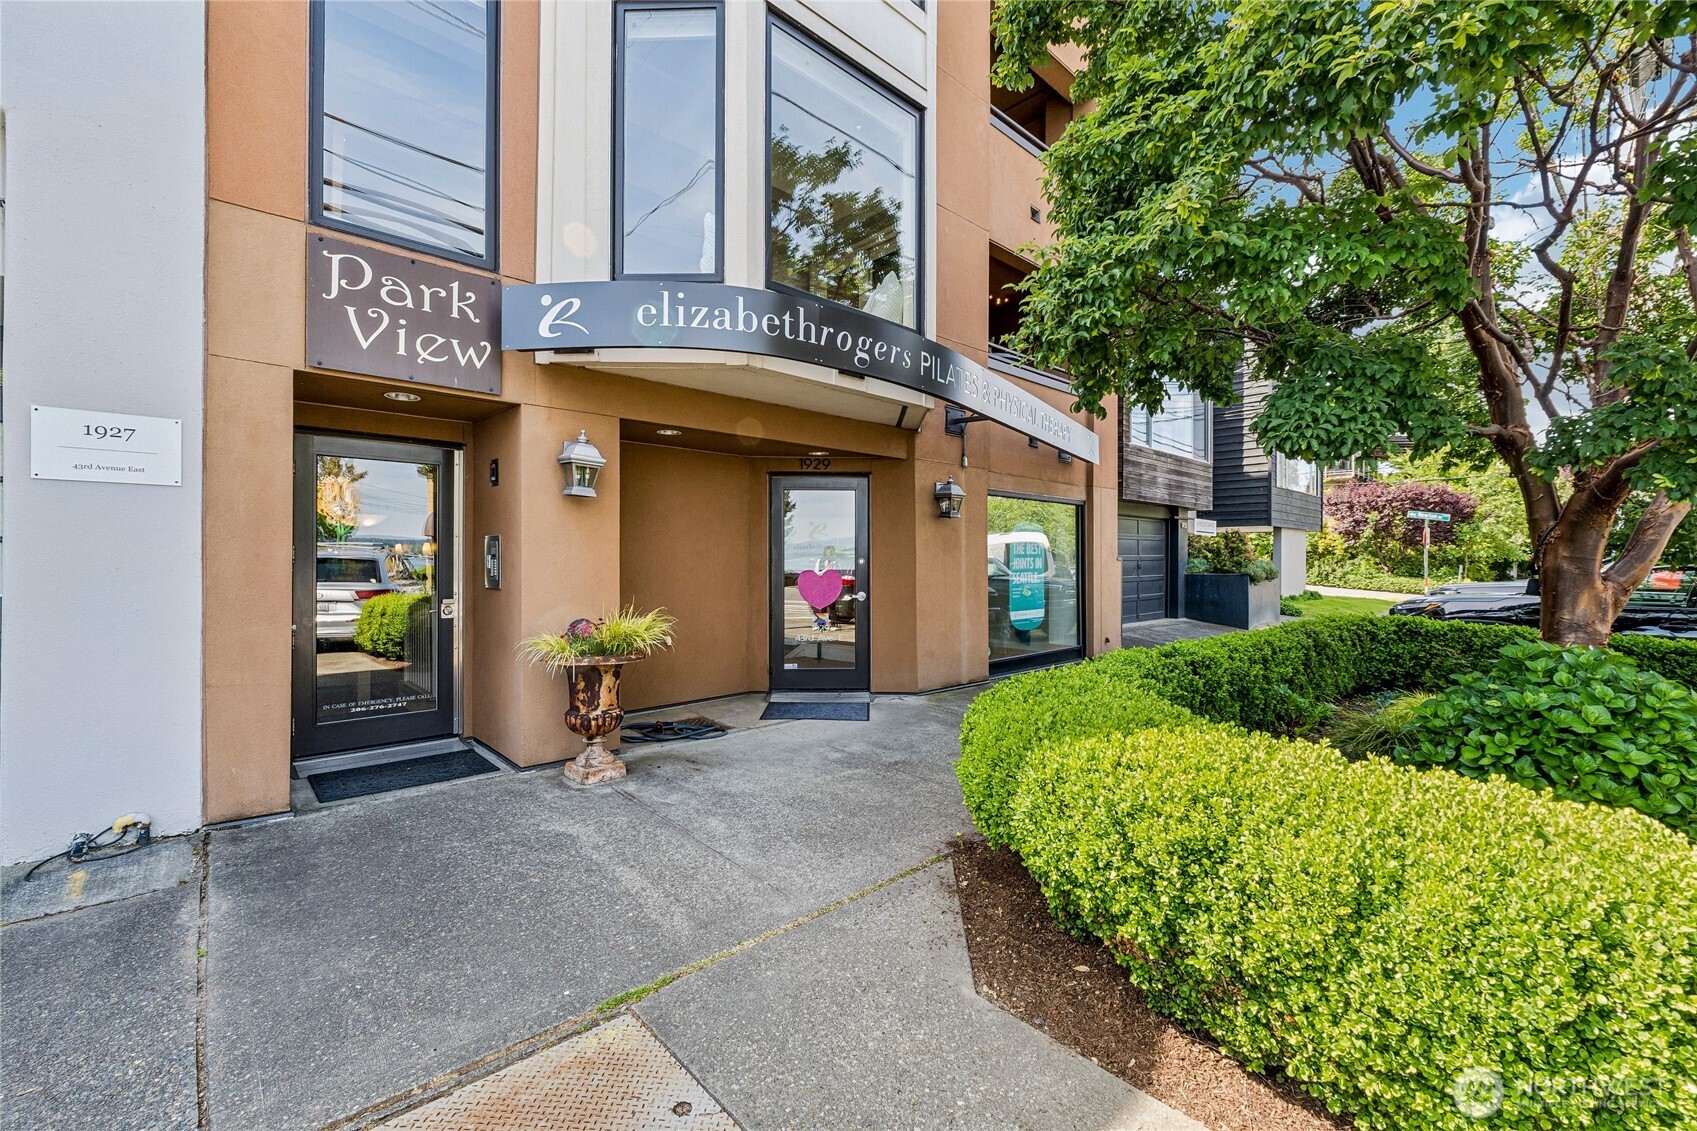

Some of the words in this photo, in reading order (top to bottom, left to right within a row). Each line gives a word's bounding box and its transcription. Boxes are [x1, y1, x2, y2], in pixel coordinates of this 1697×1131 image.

[322, 250, 480, 323] Park
[344, 305, 491, 369] View
[920, 350, 979, 398] PILATES
[982, 381, 991, 405] &
[993, 386, 1039, 428] PHYSICAL
[1040, 411, 1072, 443] THERAPY
[83, 424, 136, 442] 1927
[95, 464, 126, 472] Avenue
[799, 458, 831, 470] 1929
[1013, 543, 1025, 555] THE
[1026, 543, 1041, 555] BEST
[1012, 557, 1034, 570] JOINTS
[1035, 557, 1042, 569] IN
[795, 634, 815, 642] 43rd
